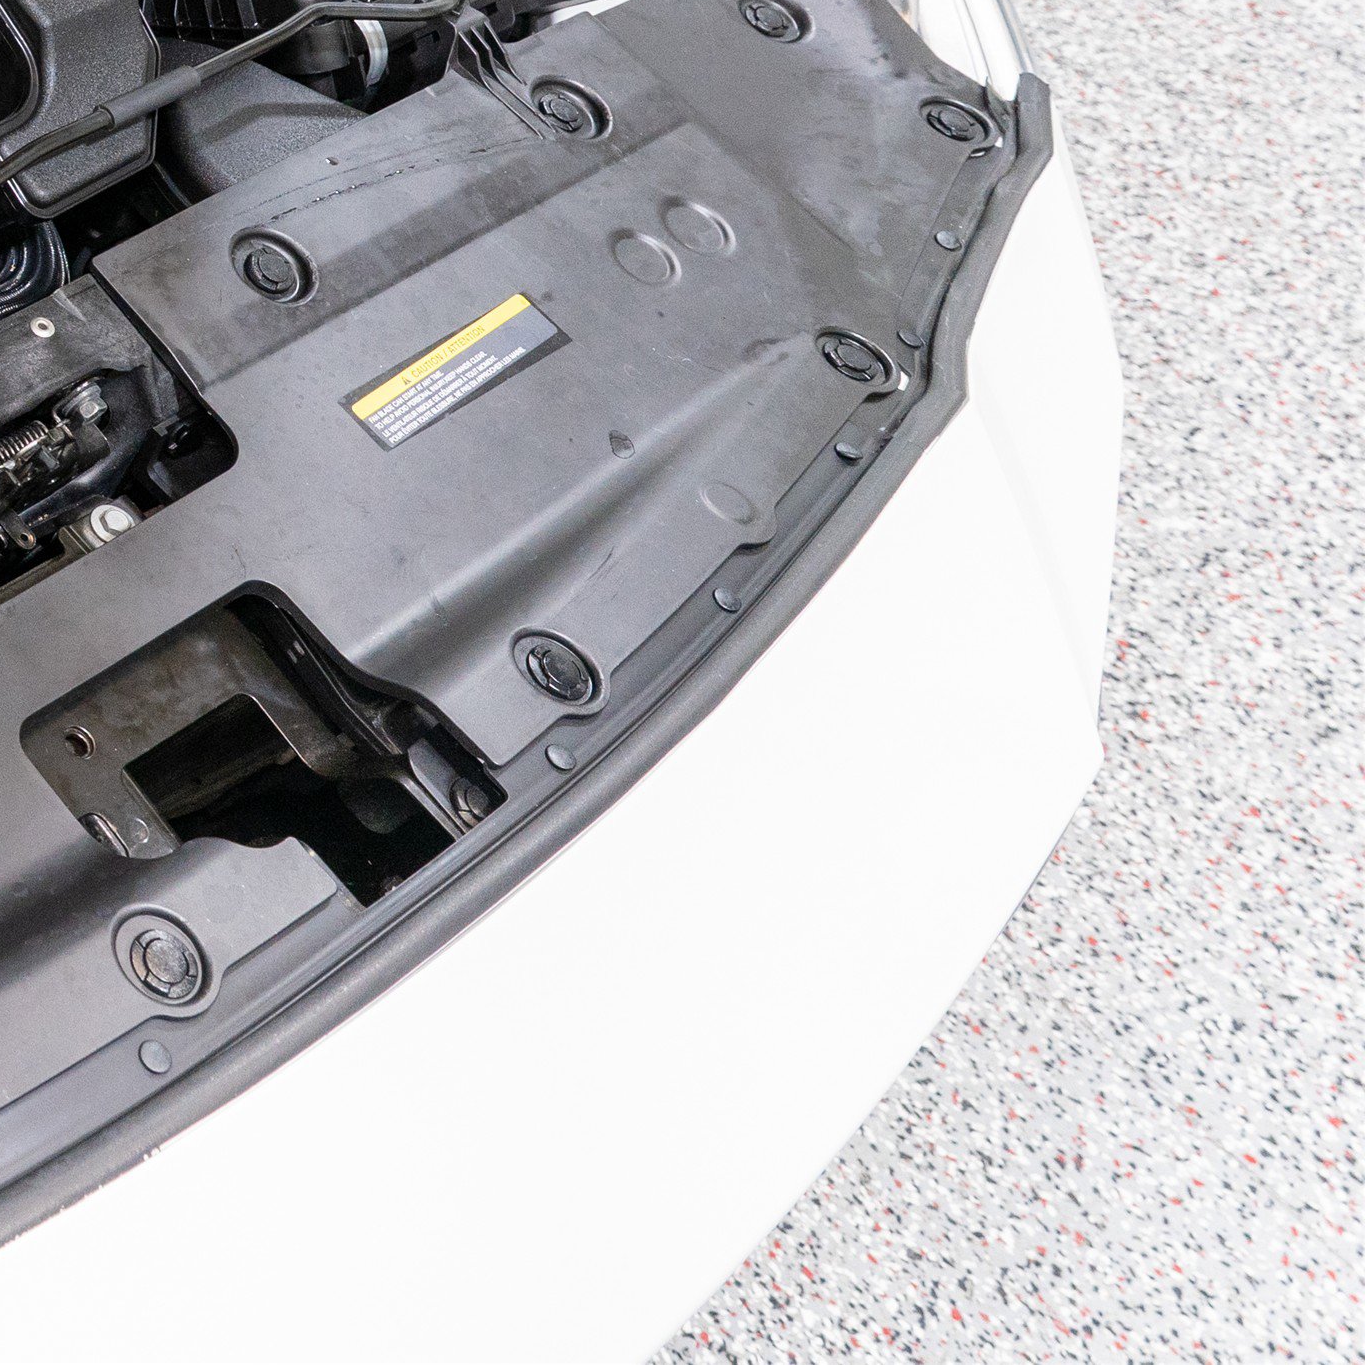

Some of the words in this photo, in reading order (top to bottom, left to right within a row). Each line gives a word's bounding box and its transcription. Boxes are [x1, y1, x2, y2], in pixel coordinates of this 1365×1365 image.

[411, 353, 444, 378] CAUTION
[447, 325, 485, 353] ATTENTION
[381, 413, 395, 425] HELP
